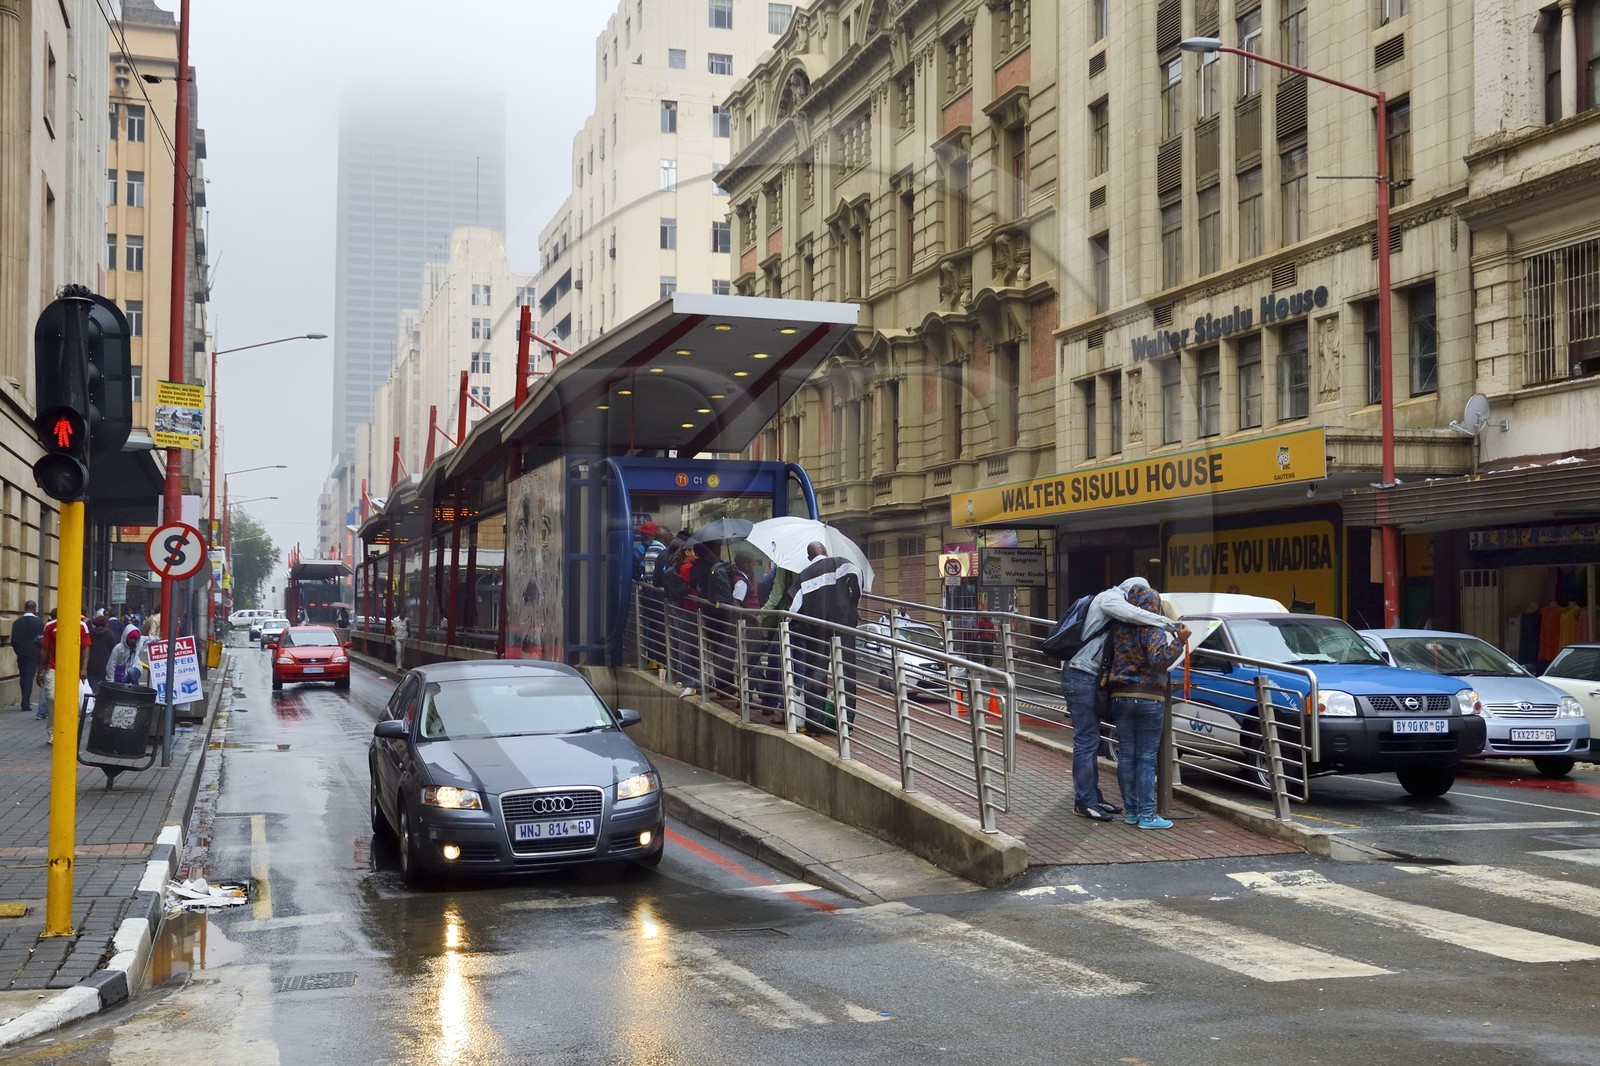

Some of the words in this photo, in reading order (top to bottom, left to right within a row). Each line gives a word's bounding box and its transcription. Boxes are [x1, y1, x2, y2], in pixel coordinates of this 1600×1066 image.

[1131, 328, 1189, 362] Walter
[1195, 306, 1253, 343] Sisulu
[1261, 286, 1328, 323] House
[1002, 480, 1066, 513] WALTER
[1072, 468, 1138, 503] SISULU
[1147, 453, 1223, 492] HOUSE
[1170, 545, 1189, 577] WE
[1193, 542, 1229, 576] LOVE
[1232, 539, 1263, 574] YOU
[1268, 534, 1332, 572] MADIBA
[175, 657, 194, 665] FEB
[1397, 721, 1406, 731] BY
[1408, 721, 1417, 731] 90
[1420, 721, 1429, 731] KR
[1436, 721, 1445, 731] GP
[1546, 731, 1554, 739] GP
[520, 824, 541, 838] WNJ
[548, 822, 569, 836] 814
[578, 821, 591, 834] GP
